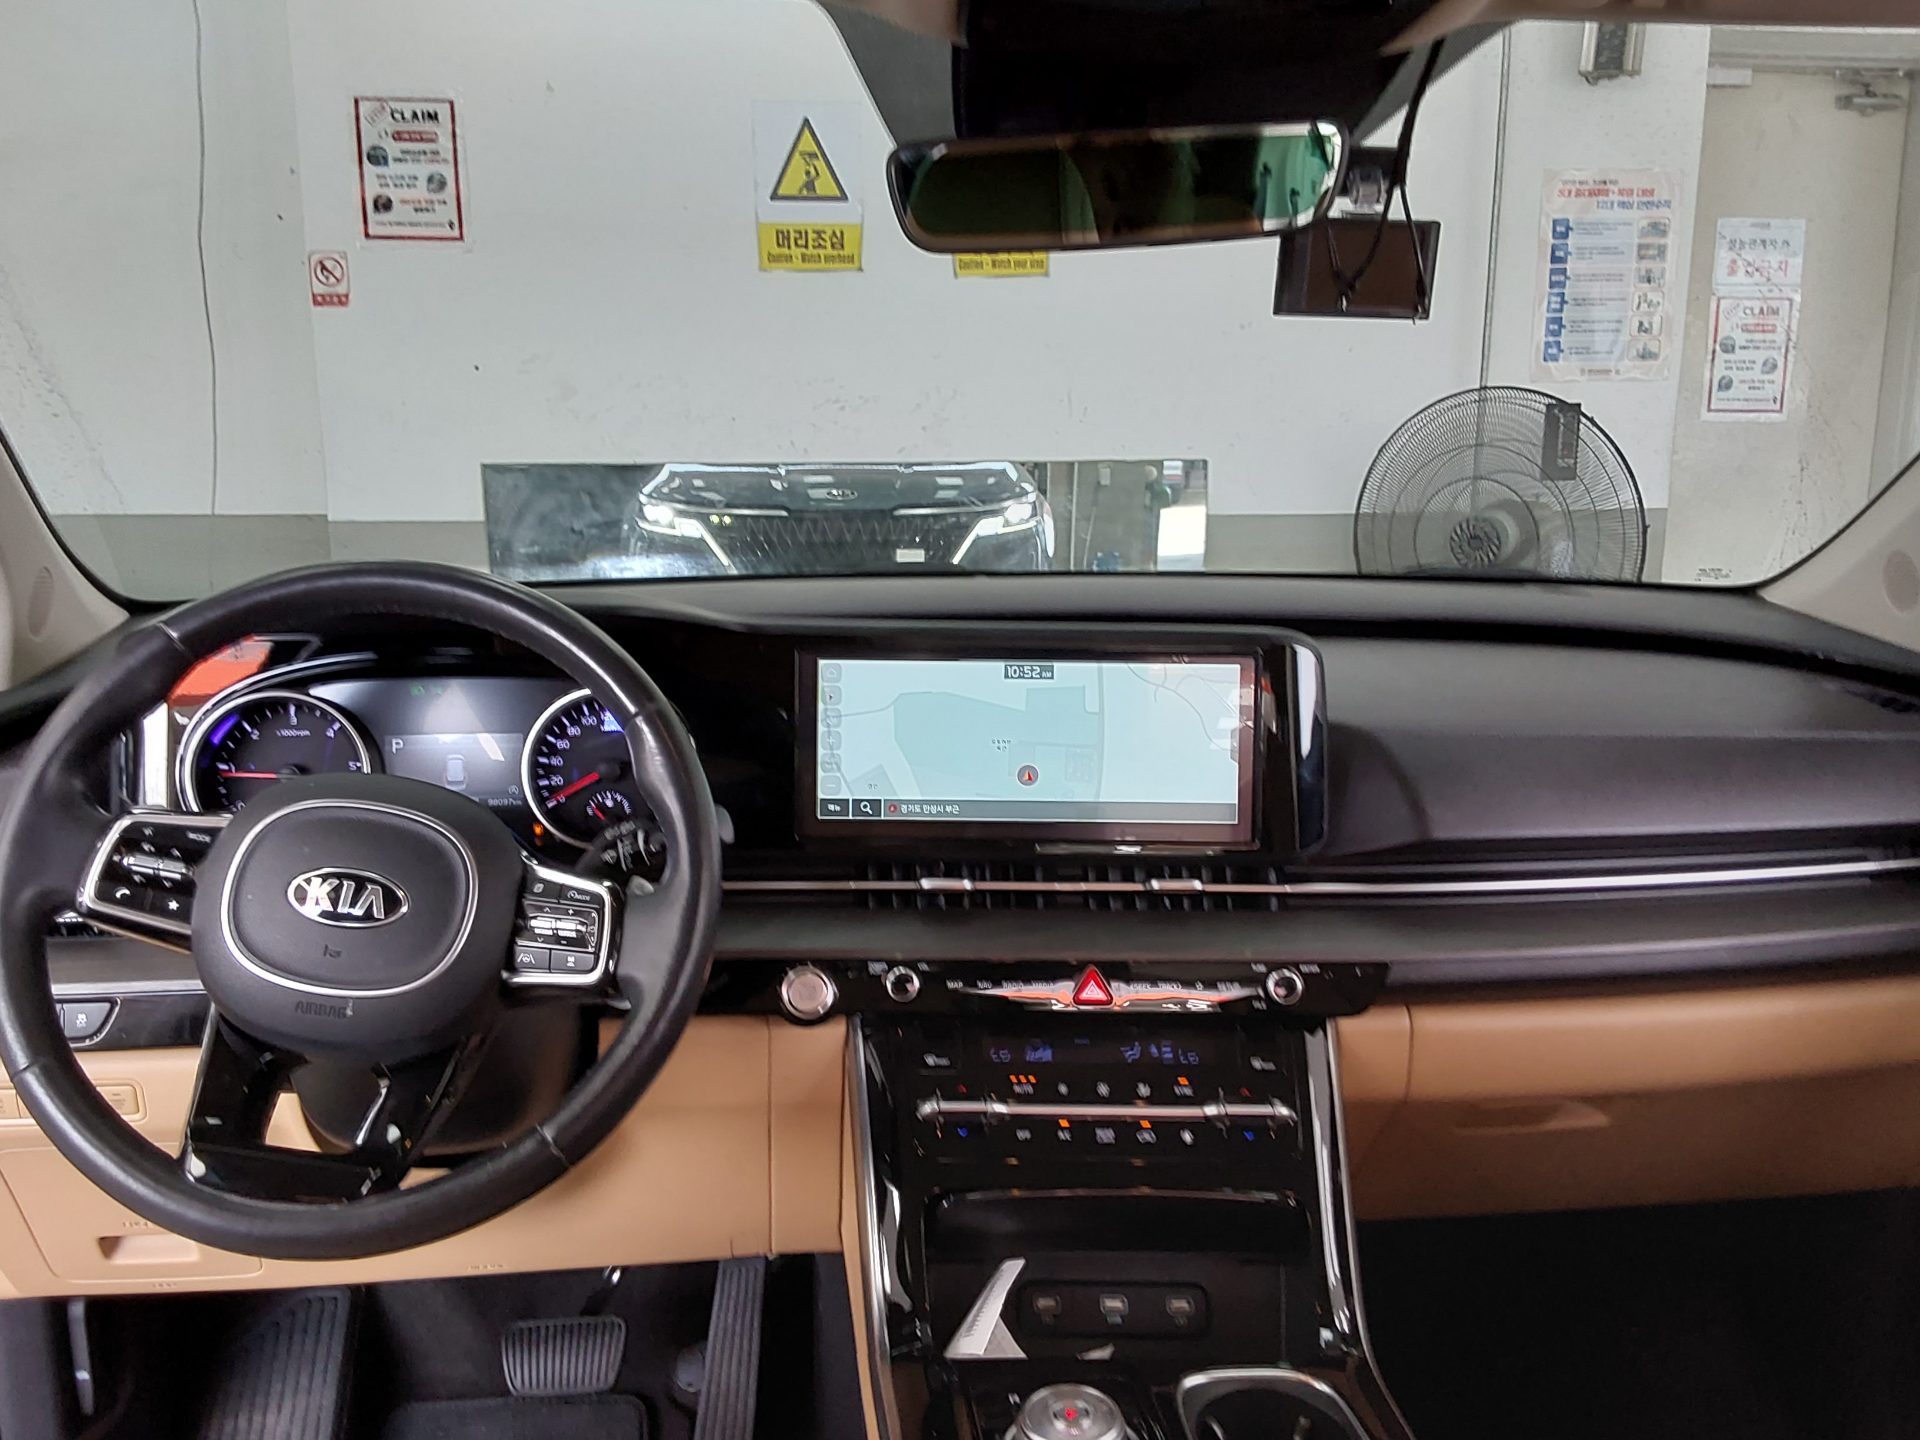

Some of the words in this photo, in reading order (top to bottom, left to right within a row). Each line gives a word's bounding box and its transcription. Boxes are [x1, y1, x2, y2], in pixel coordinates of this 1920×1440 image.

[391, 107, 440, 123] CLAIM
[775, 228, 845, 250] 머리조심
[1743, 305, 1780, 317] CLAIM
[1006, 665, 1041, 679] 10:52
[391, 738, 404, 754] P
[900, 804, 922, 814] 경기도
[301, 876, 386, 920] KIA
[947, 980, 963, 990] MAP
